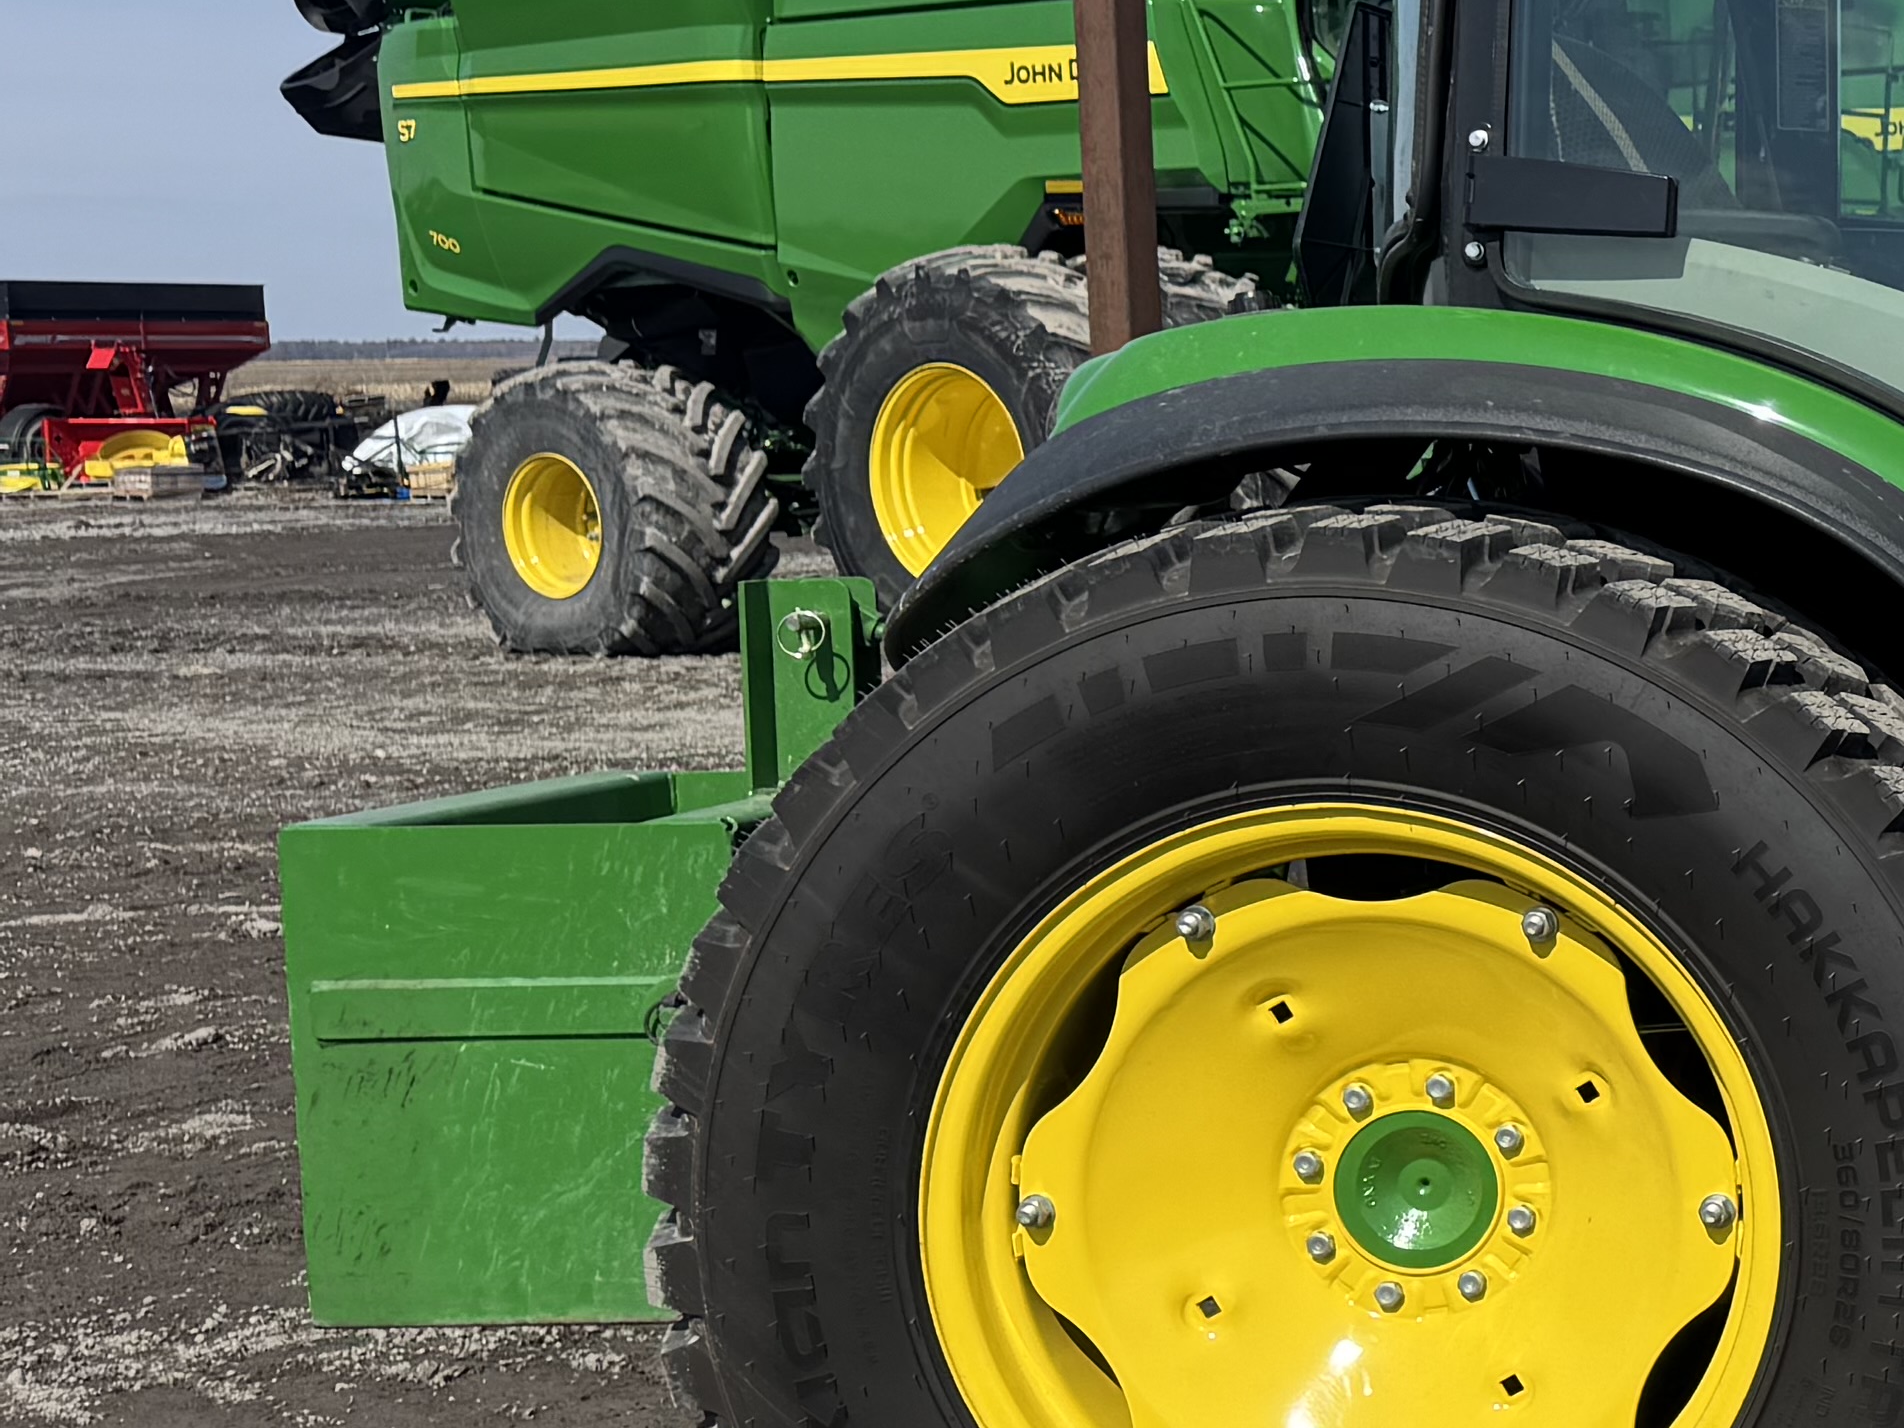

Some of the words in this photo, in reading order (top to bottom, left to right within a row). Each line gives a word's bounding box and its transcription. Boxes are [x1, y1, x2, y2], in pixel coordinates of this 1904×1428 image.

[1004, 60, 1063, 85] JOHN
[398, 119, 416, 142] S7
[429, 230, 461, 254] 700
[750, 808, 964, 1186] TYRES
